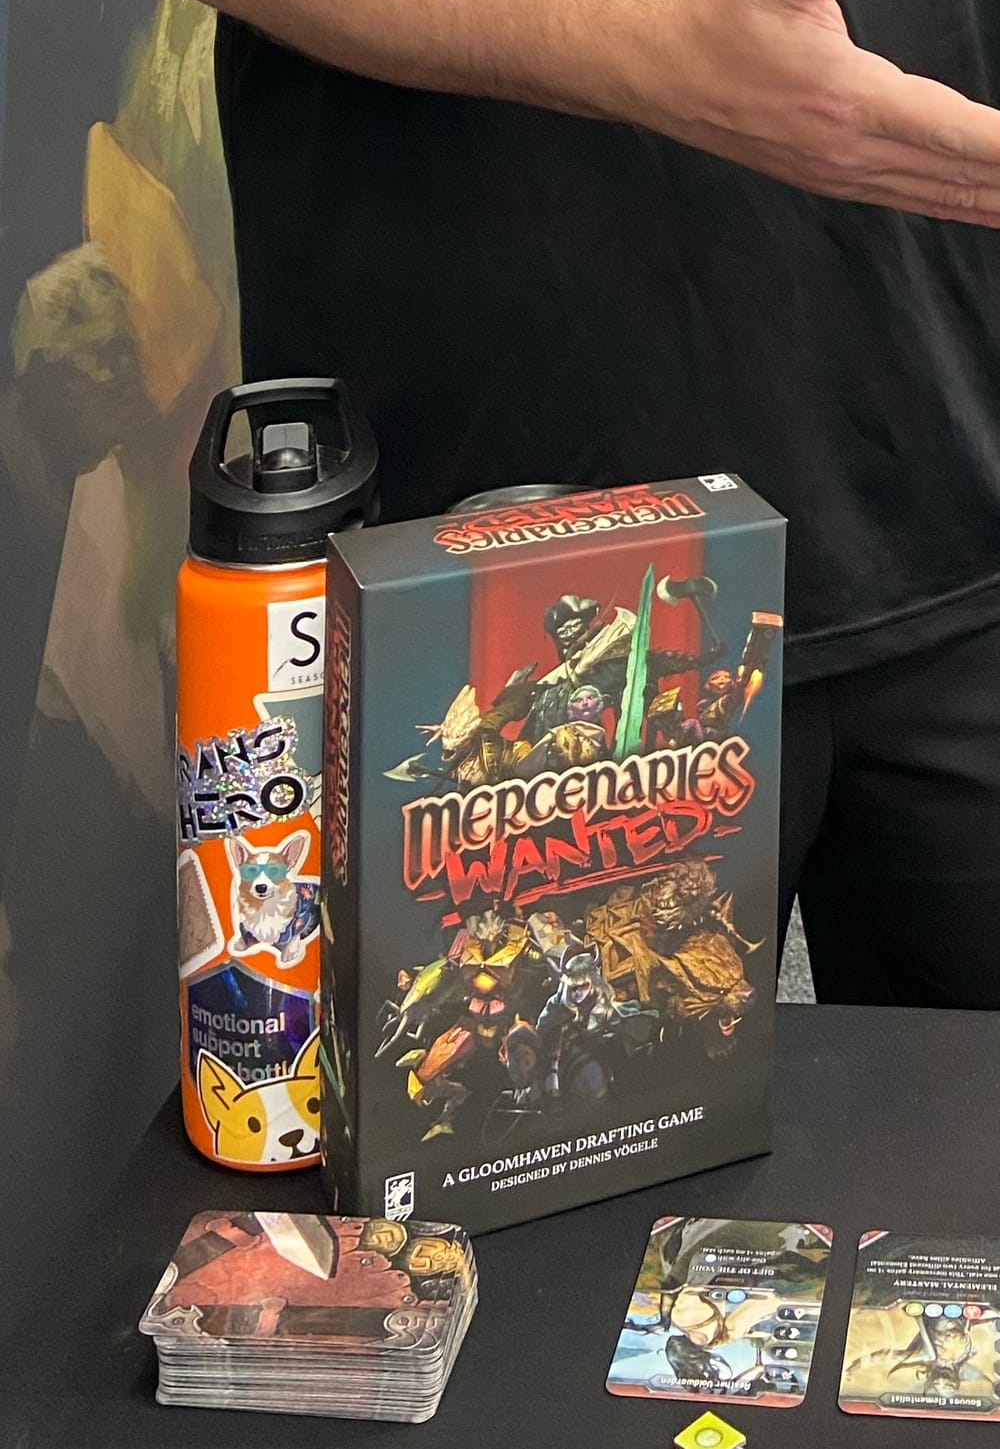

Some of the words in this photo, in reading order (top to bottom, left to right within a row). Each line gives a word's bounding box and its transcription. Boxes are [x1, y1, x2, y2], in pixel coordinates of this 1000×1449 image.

[290, 611, 320, 666] S
[180, 776, 304, 840] HERO
[402, 736, 755, 890] MERCENARIES
[445, 800, 712, 904] WANTED
[191, 1004, 285, 1035] emotional
[192, 1027, 261, 1057] support
[443, 1174, 454, 1188] A
[458, 1142, 572, 1183] GLOOMHAVEN
[575, 1120, 654, 1152] DRAFTING
[658, 1107, 704, 1130] GAME
[491, 1168, 549, 1192] DESIGNED
[552, 1164, 567, 1175] BY
[570, 1152, 611, 1171] DENNIS
[614, 1138, 658, 1159] VÖGELE
[891, 1395, 946, 1406] Elementalist
